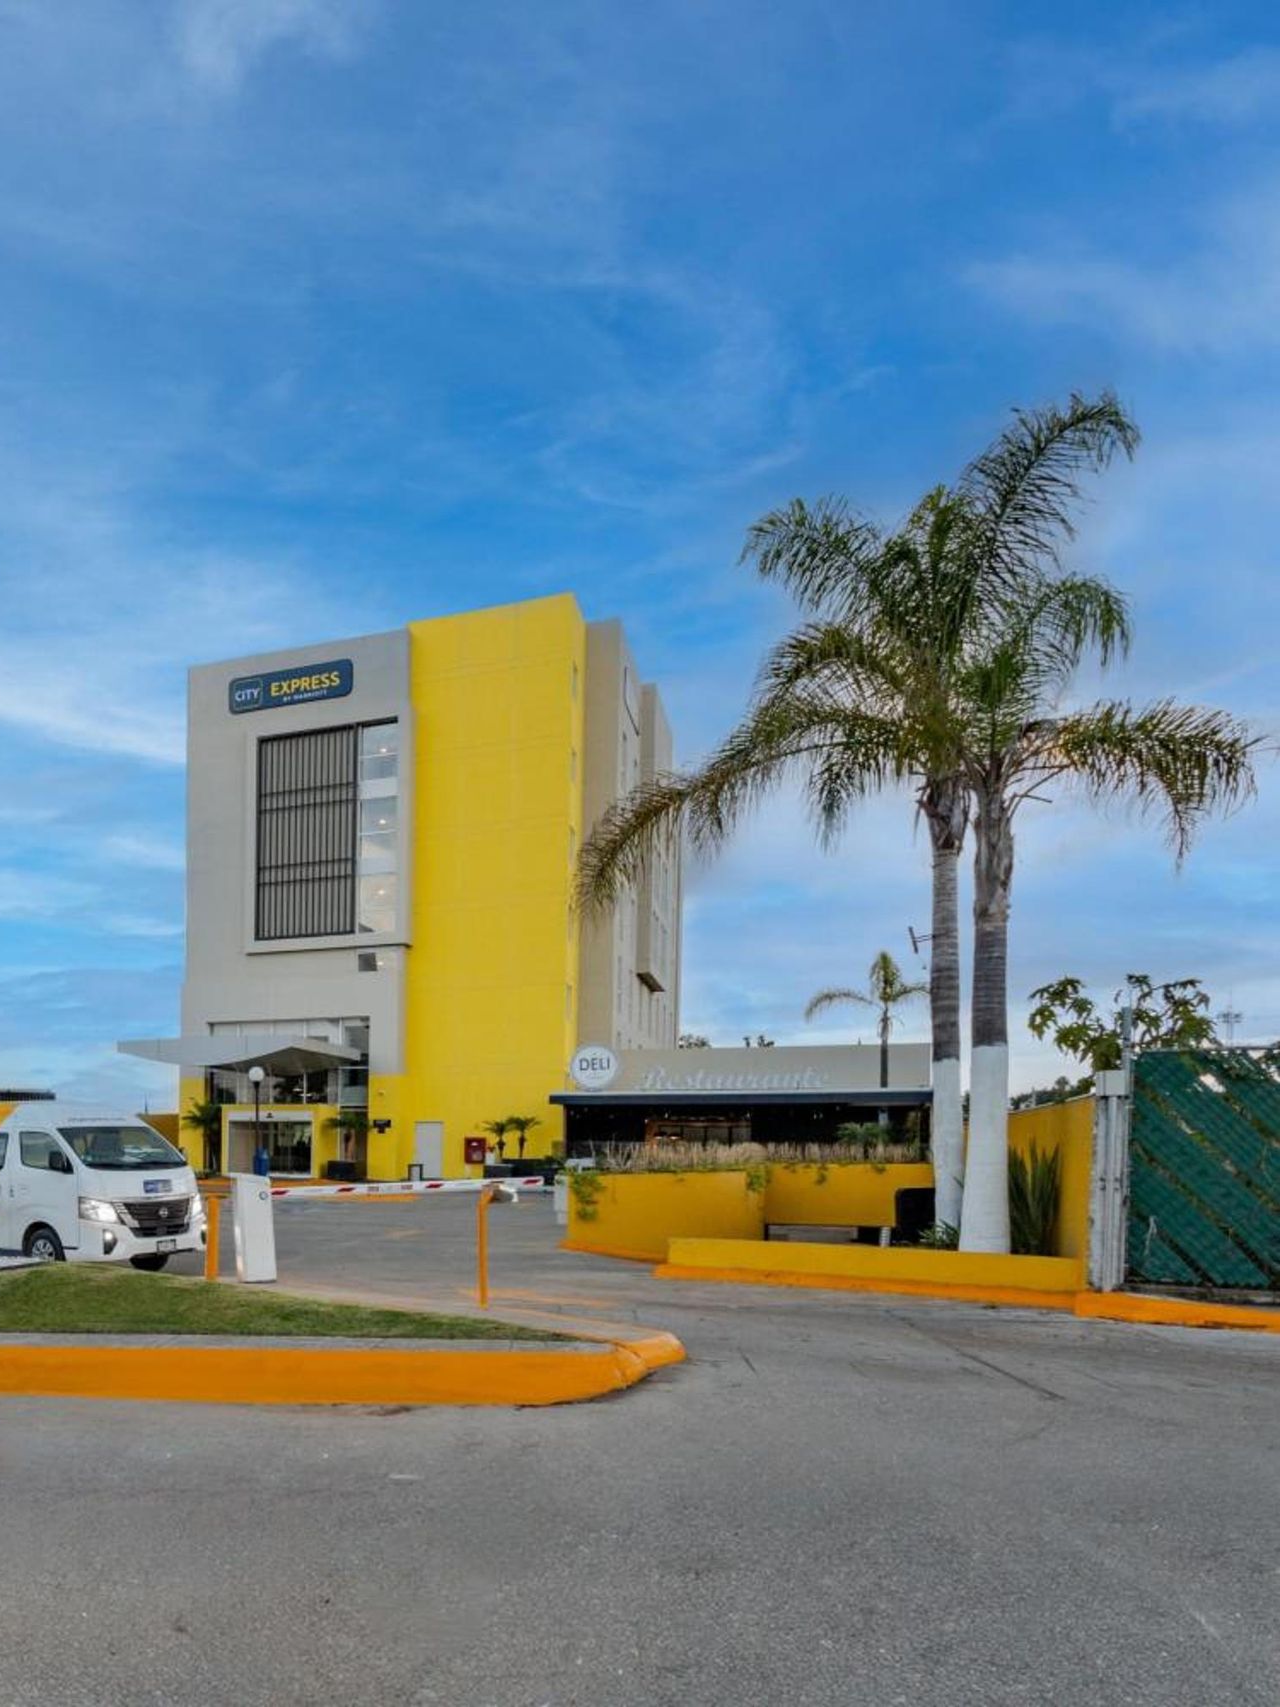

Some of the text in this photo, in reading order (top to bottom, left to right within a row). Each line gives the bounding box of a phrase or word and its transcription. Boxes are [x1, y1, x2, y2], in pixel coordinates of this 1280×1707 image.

[234, 671, 340, 702] CITY EXPRESS
[579, 1056, 610, 1071] DELI
